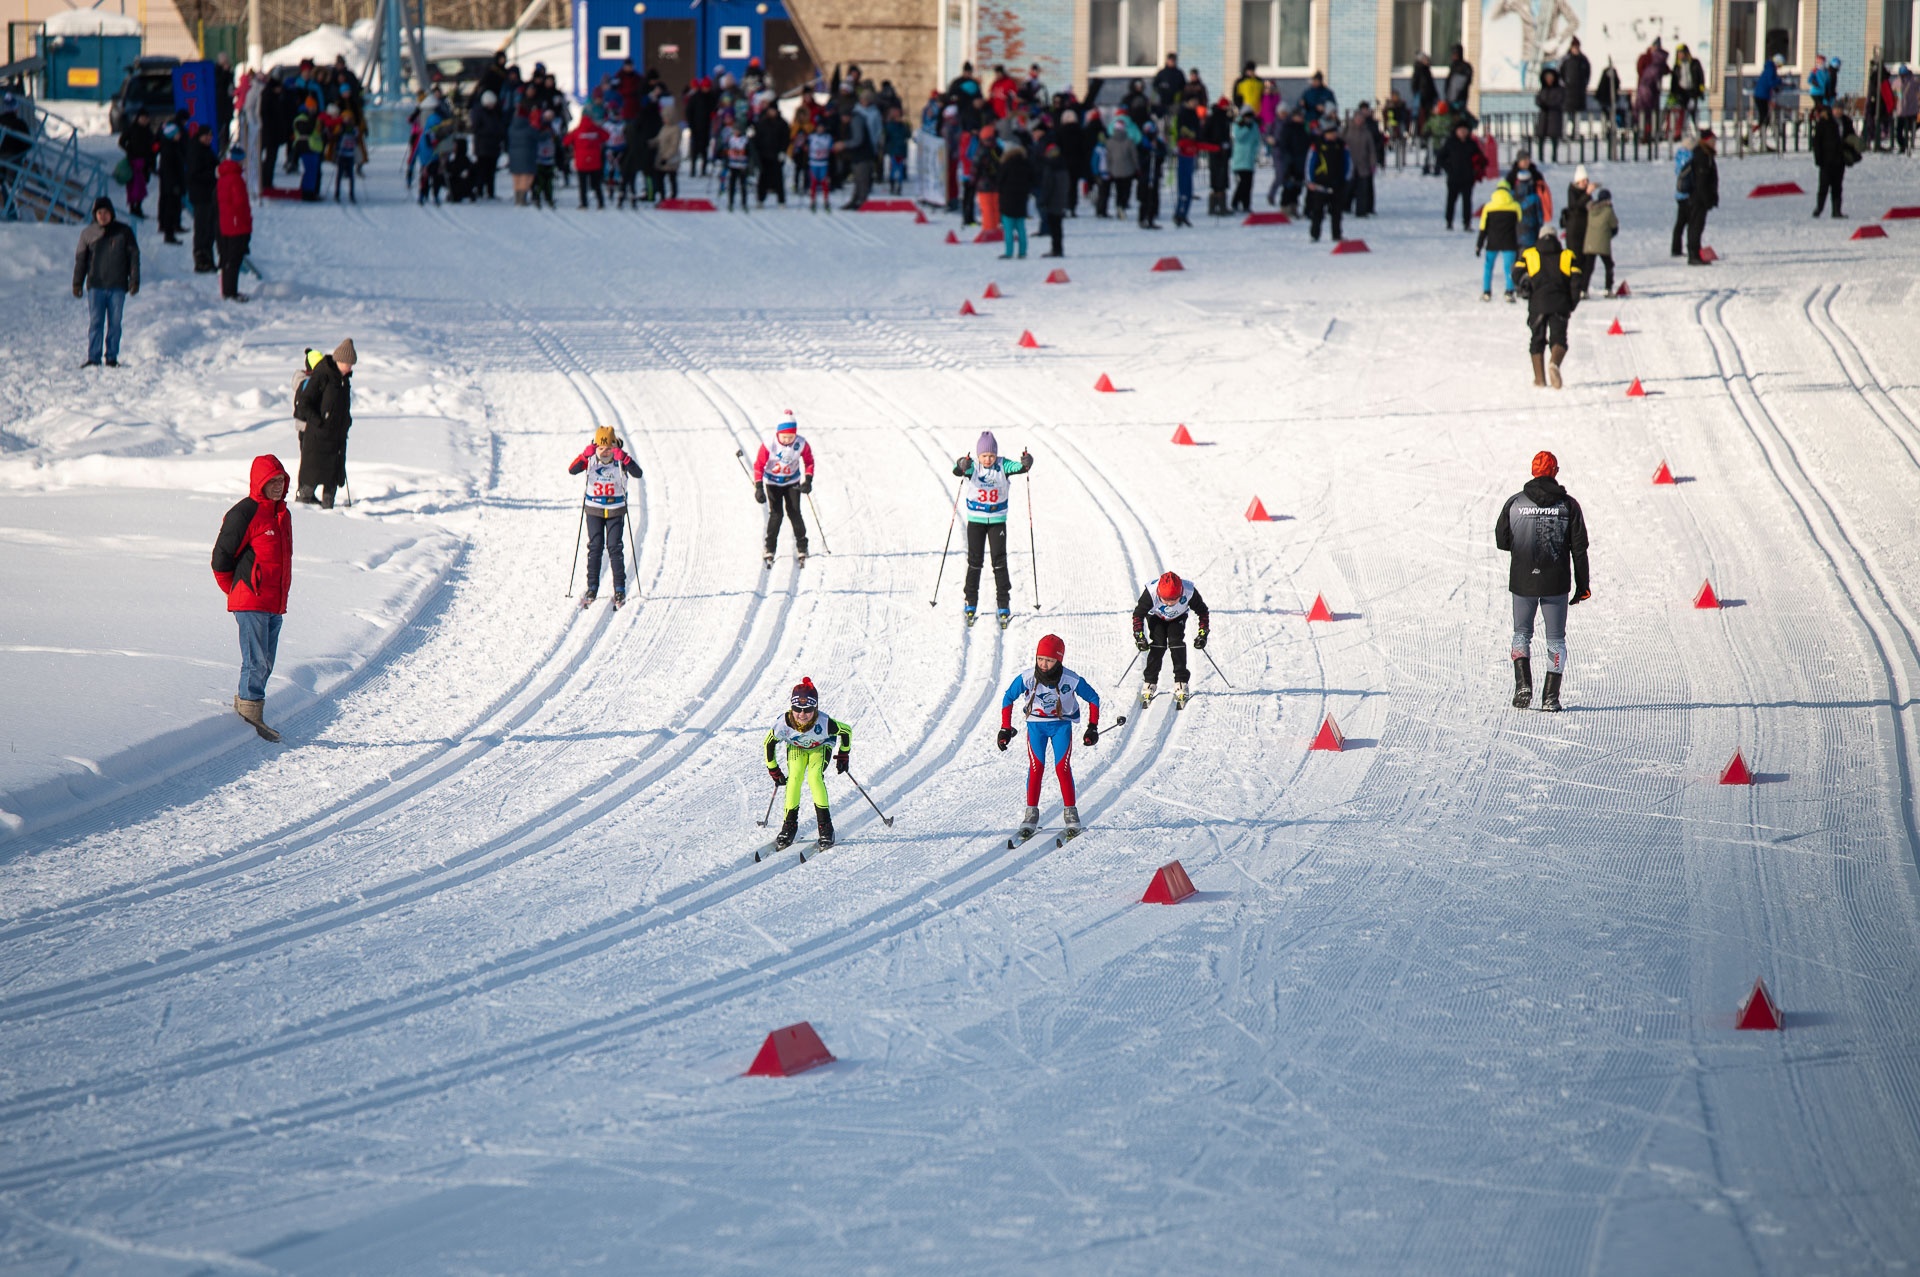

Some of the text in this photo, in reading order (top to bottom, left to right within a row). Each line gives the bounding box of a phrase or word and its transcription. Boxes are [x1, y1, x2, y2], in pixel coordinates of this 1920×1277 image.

[593, 481, 616, 496] 36
[977, 488, 999, 503] 38
[1518, 507, 1560, 516] УДМУРТИЯ
